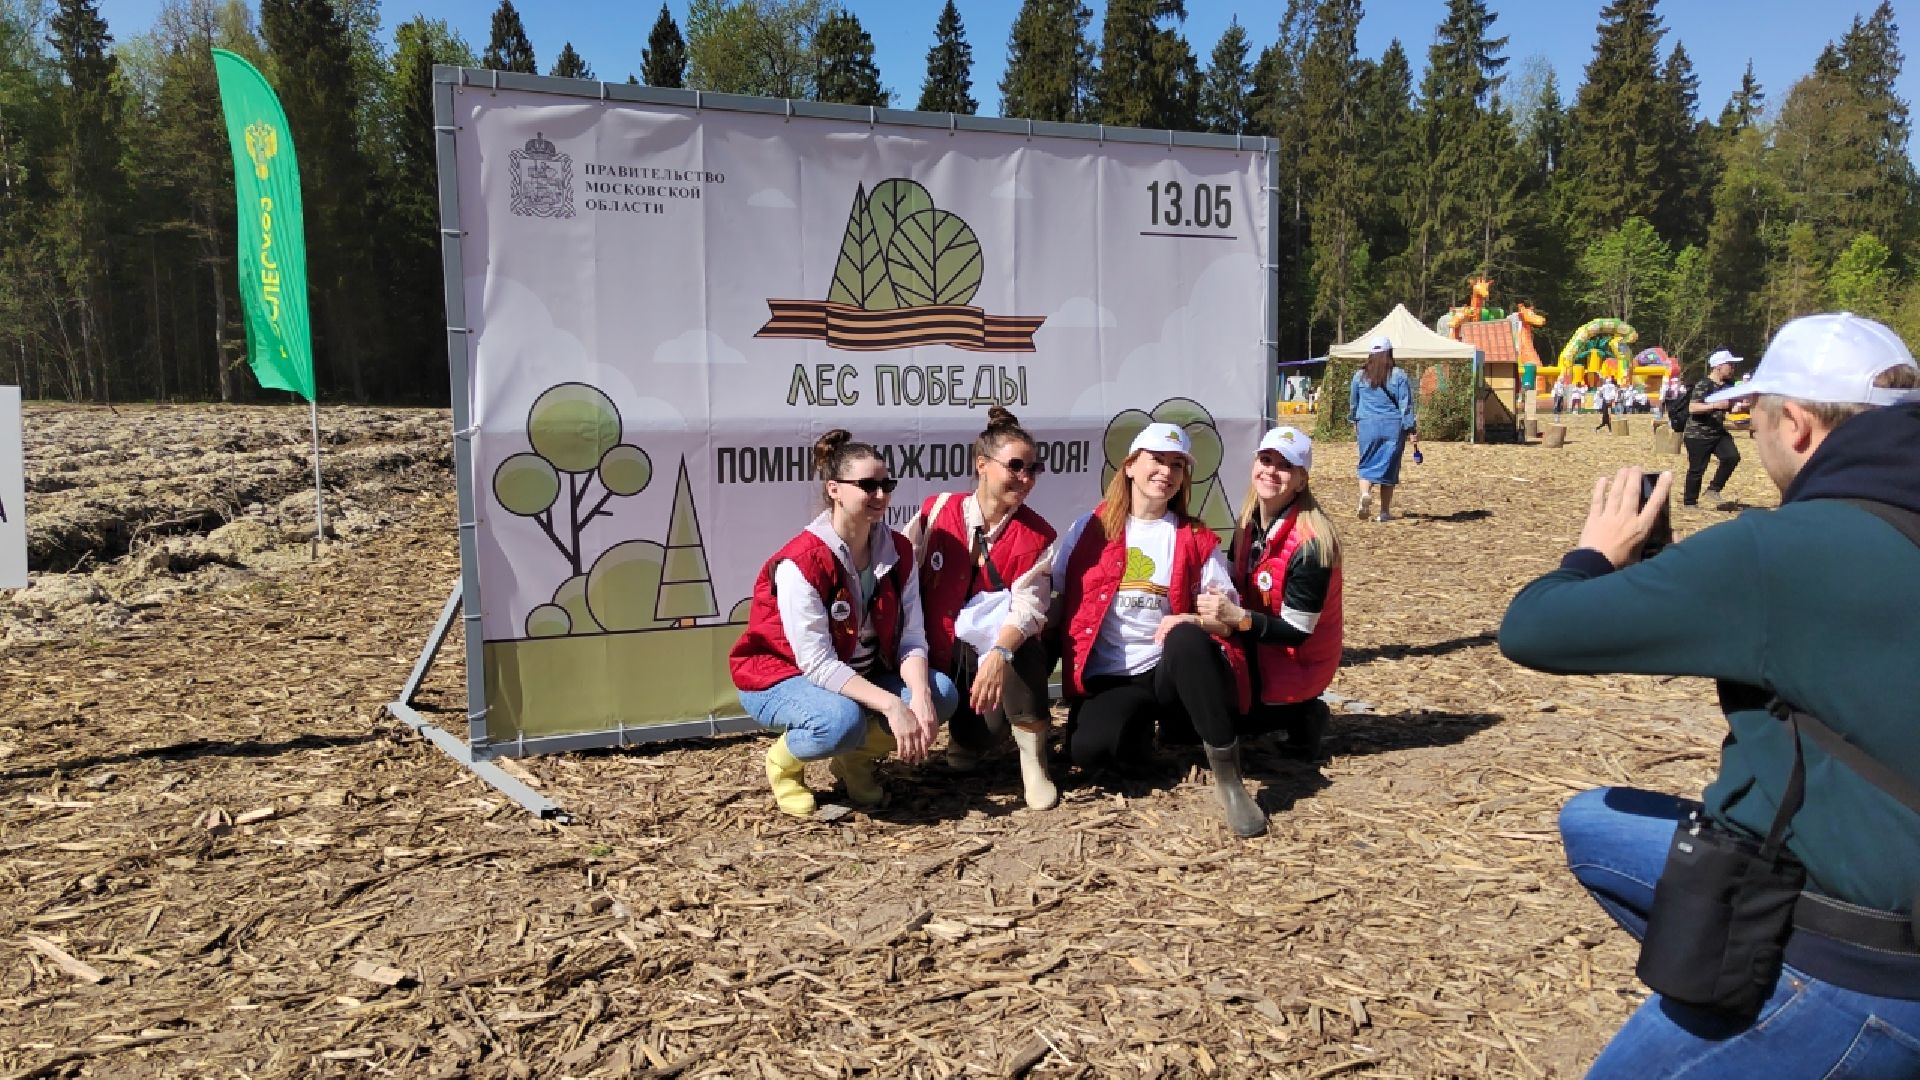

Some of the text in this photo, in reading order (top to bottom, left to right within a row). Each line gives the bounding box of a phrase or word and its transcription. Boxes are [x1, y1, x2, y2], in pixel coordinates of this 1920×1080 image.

[585, 163, 725, 184] ПРАВИТЕЛЬСТВО
[585, 181, 700, 199] МОСКОВСКОЙ
[585, 199, 664, 214] ОБЛАСТИ
[1147, 180, 1232, 229] 13.05
[787, 364, 1028, 409] ЛЕС ПОБЕДЫ
[1035, 440, 1090, 474] РОЯ!
